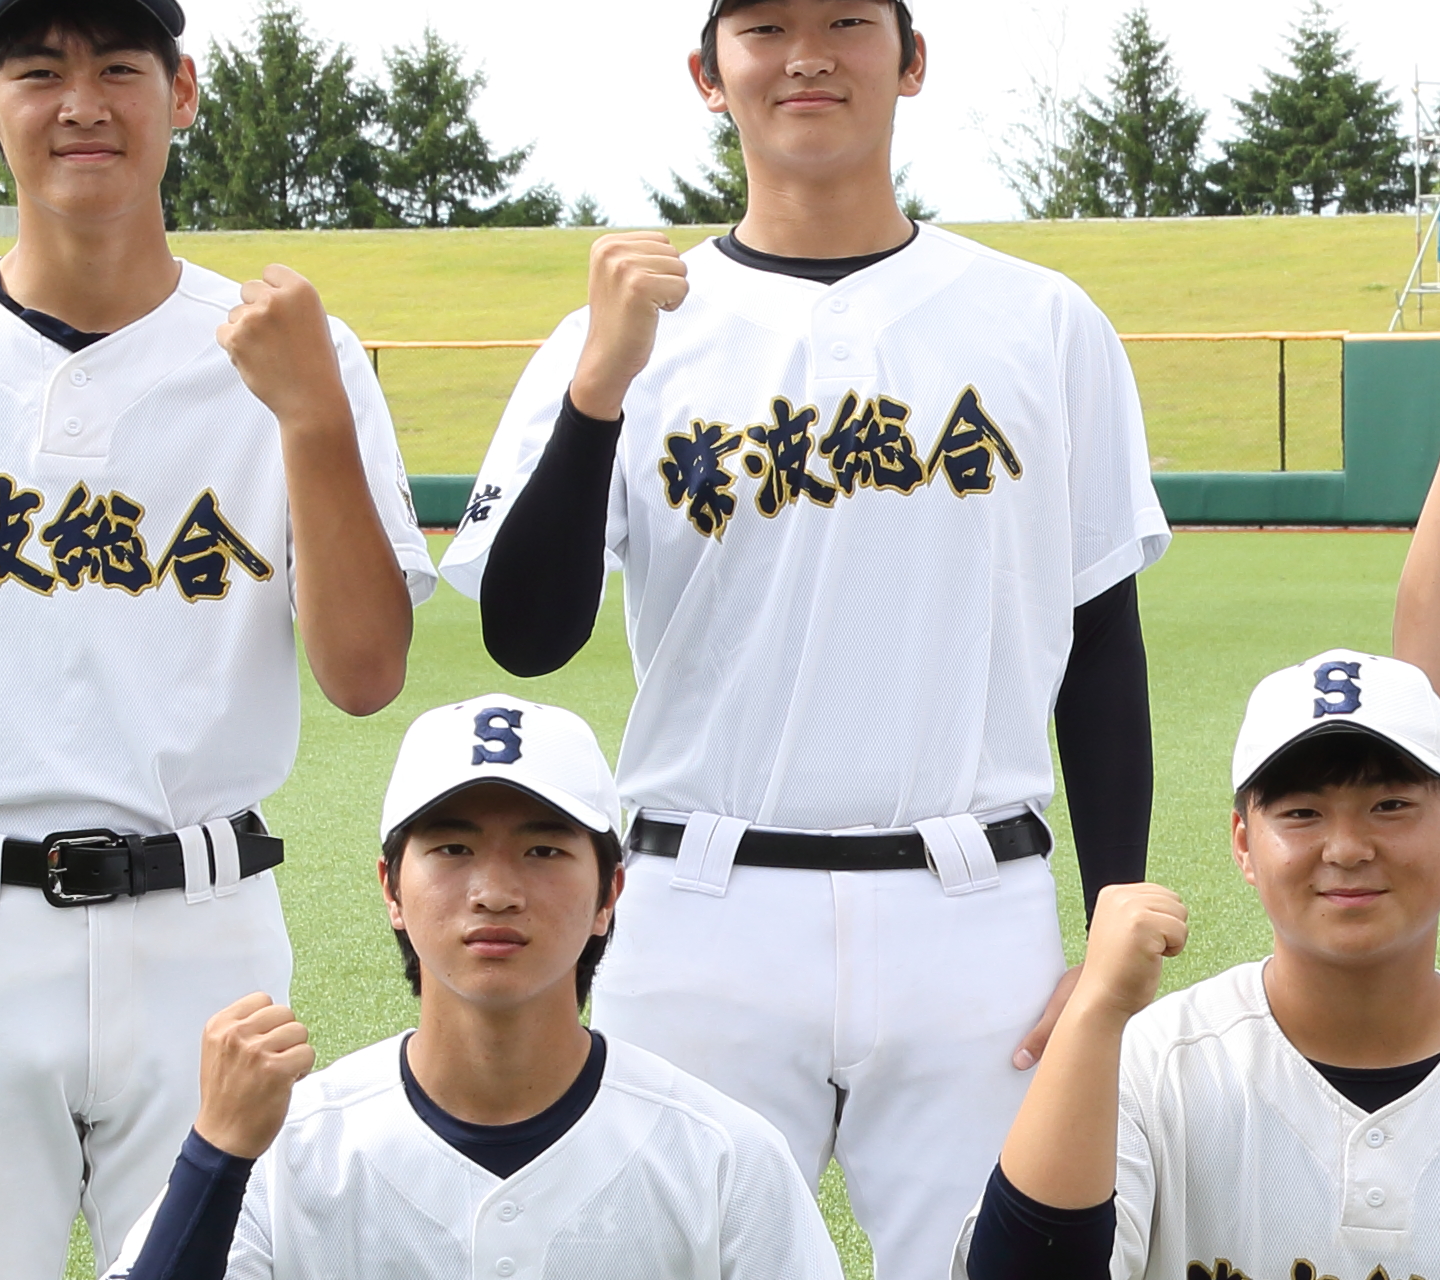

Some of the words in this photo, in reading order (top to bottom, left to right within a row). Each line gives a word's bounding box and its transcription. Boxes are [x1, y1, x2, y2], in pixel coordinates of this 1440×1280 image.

[660, 385, 1022, 542] 紫波総合
[1313, 661, 1362, 717] S
[471, 708, 523, 765] S
